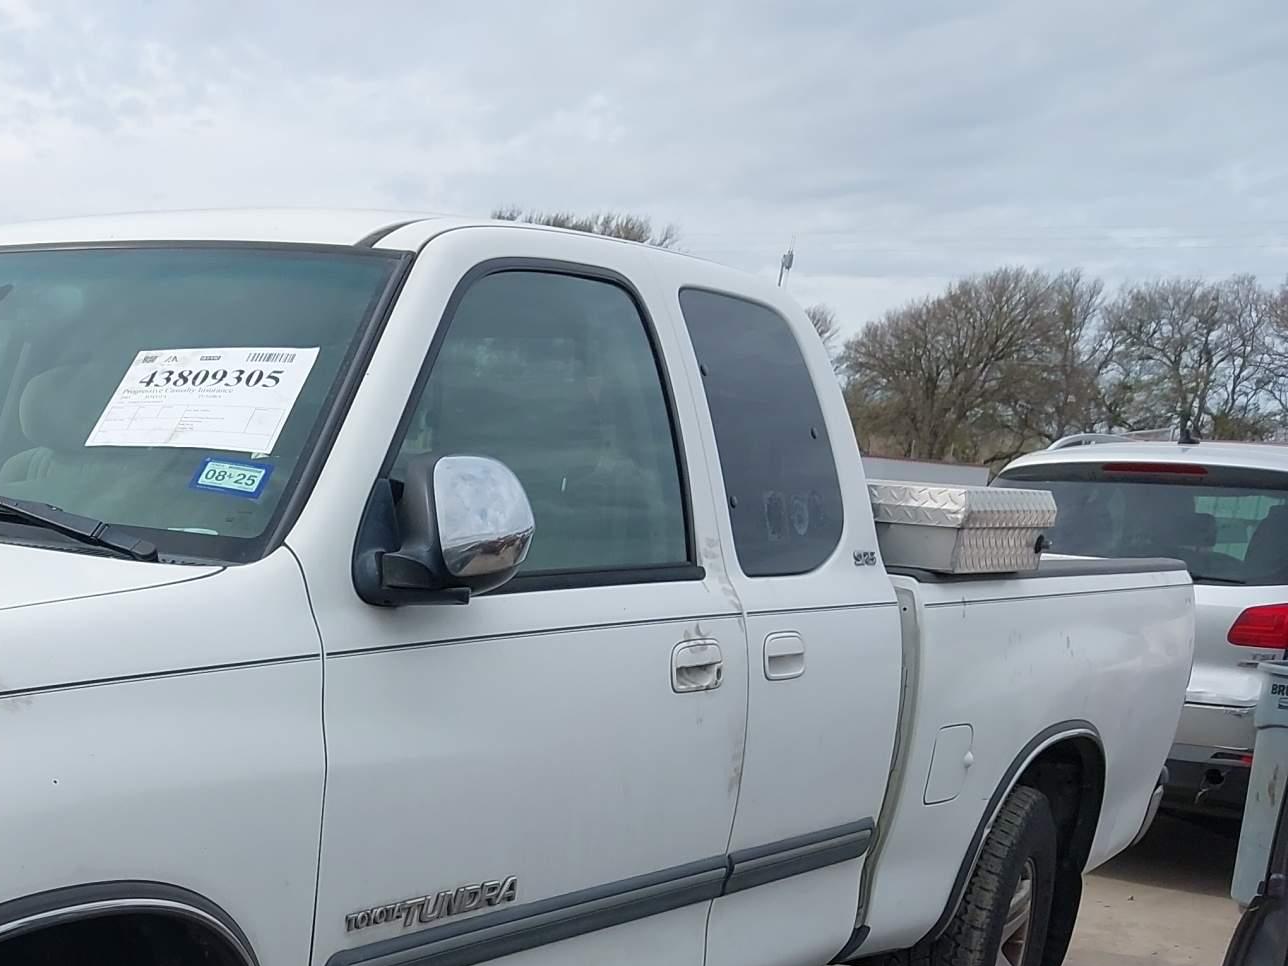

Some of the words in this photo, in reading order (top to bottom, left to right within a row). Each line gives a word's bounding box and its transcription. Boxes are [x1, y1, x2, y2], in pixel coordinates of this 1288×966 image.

[139, 369, 284, 387] 43809305
[205, 469, 227, 481] 08
[233, 473, 257, 486] 25
[345, 903, 403, 932] TOYOTA
[401, 875, 517, 928] TUNDRA
